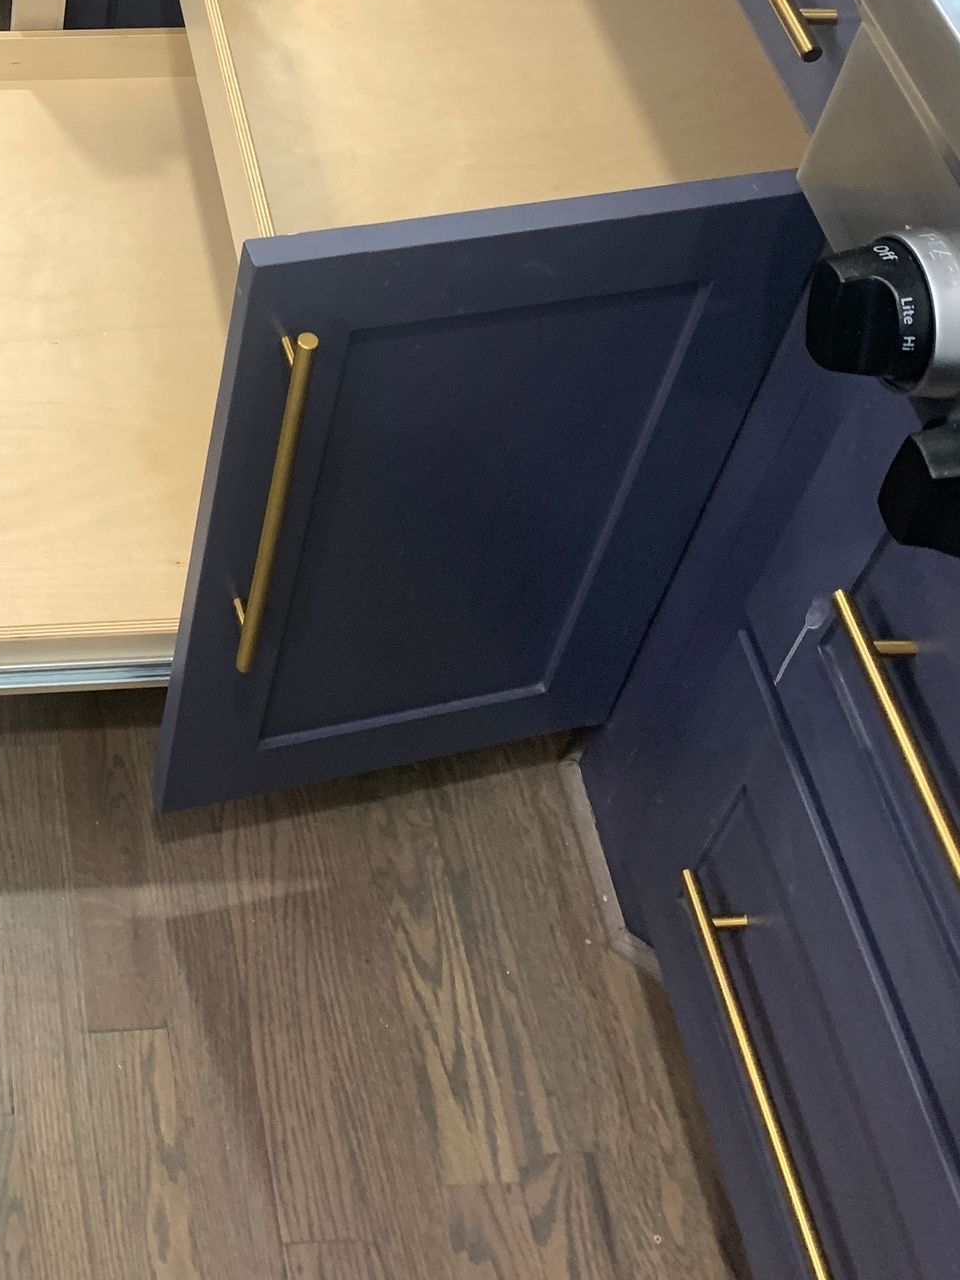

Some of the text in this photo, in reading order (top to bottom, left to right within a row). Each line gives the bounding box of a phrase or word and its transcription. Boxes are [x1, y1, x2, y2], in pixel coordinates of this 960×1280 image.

[872, 245, 898, 261] Off
[900, 296, 916, 325] Lite
[902, 335, 916, 351] Hi
